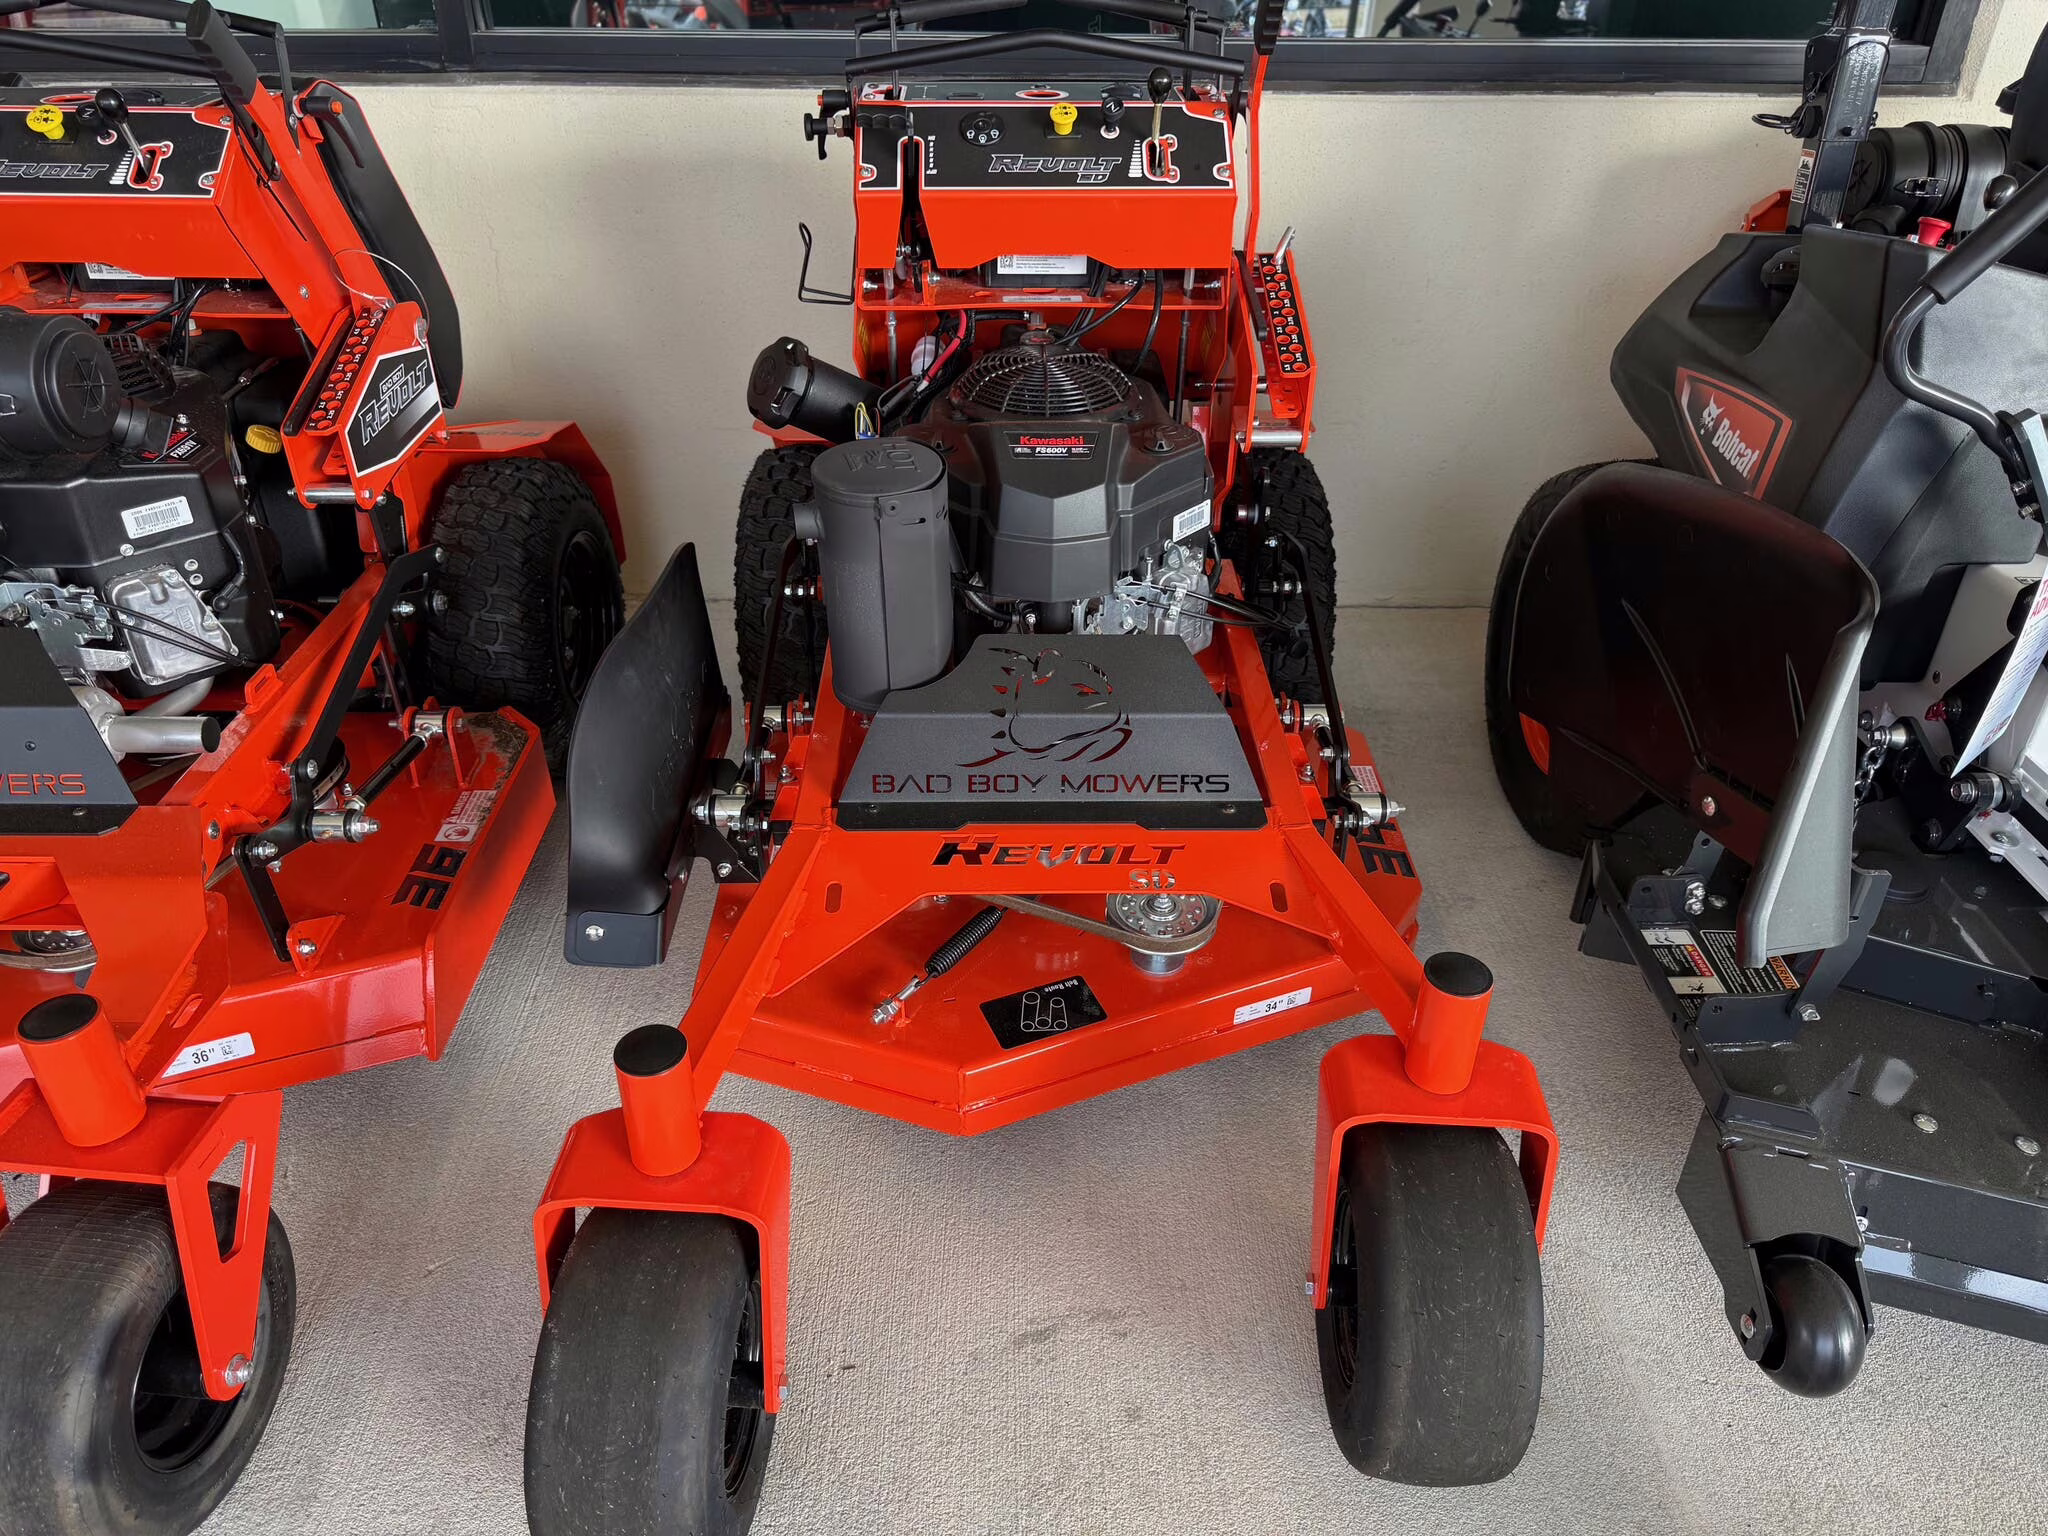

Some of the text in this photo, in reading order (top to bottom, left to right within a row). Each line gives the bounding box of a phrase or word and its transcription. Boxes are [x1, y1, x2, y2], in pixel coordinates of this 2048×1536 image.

[0, 160, 109, 179] EVOLT
[988, 154, 1122, 173] REVOLT
[382, 371, 403, 393] BAD BOY
[358, 359, 428, 446] REVOLT
[1020, 435, 1084, 445] Kawasaki
[1711, 417, 1760, 478] Bobcat
[0, 773, 87, 796] ERS
[871, 774, 1230, 793] BAD BOY MOWERS
[931, 834, 1186, 869] REVOLT
[390, 843, 468, 912] 36
[1129, 869, 1176, 889] SD
[1691, 951, 1713, 977] DANGER
[1770, 957, 1797, 990] WARNI
[1044, 979, 1079, 993] Belt Route
[1265, 999, 1284, 1013] 34"
[191, 1047, 215, 1065] 36"
